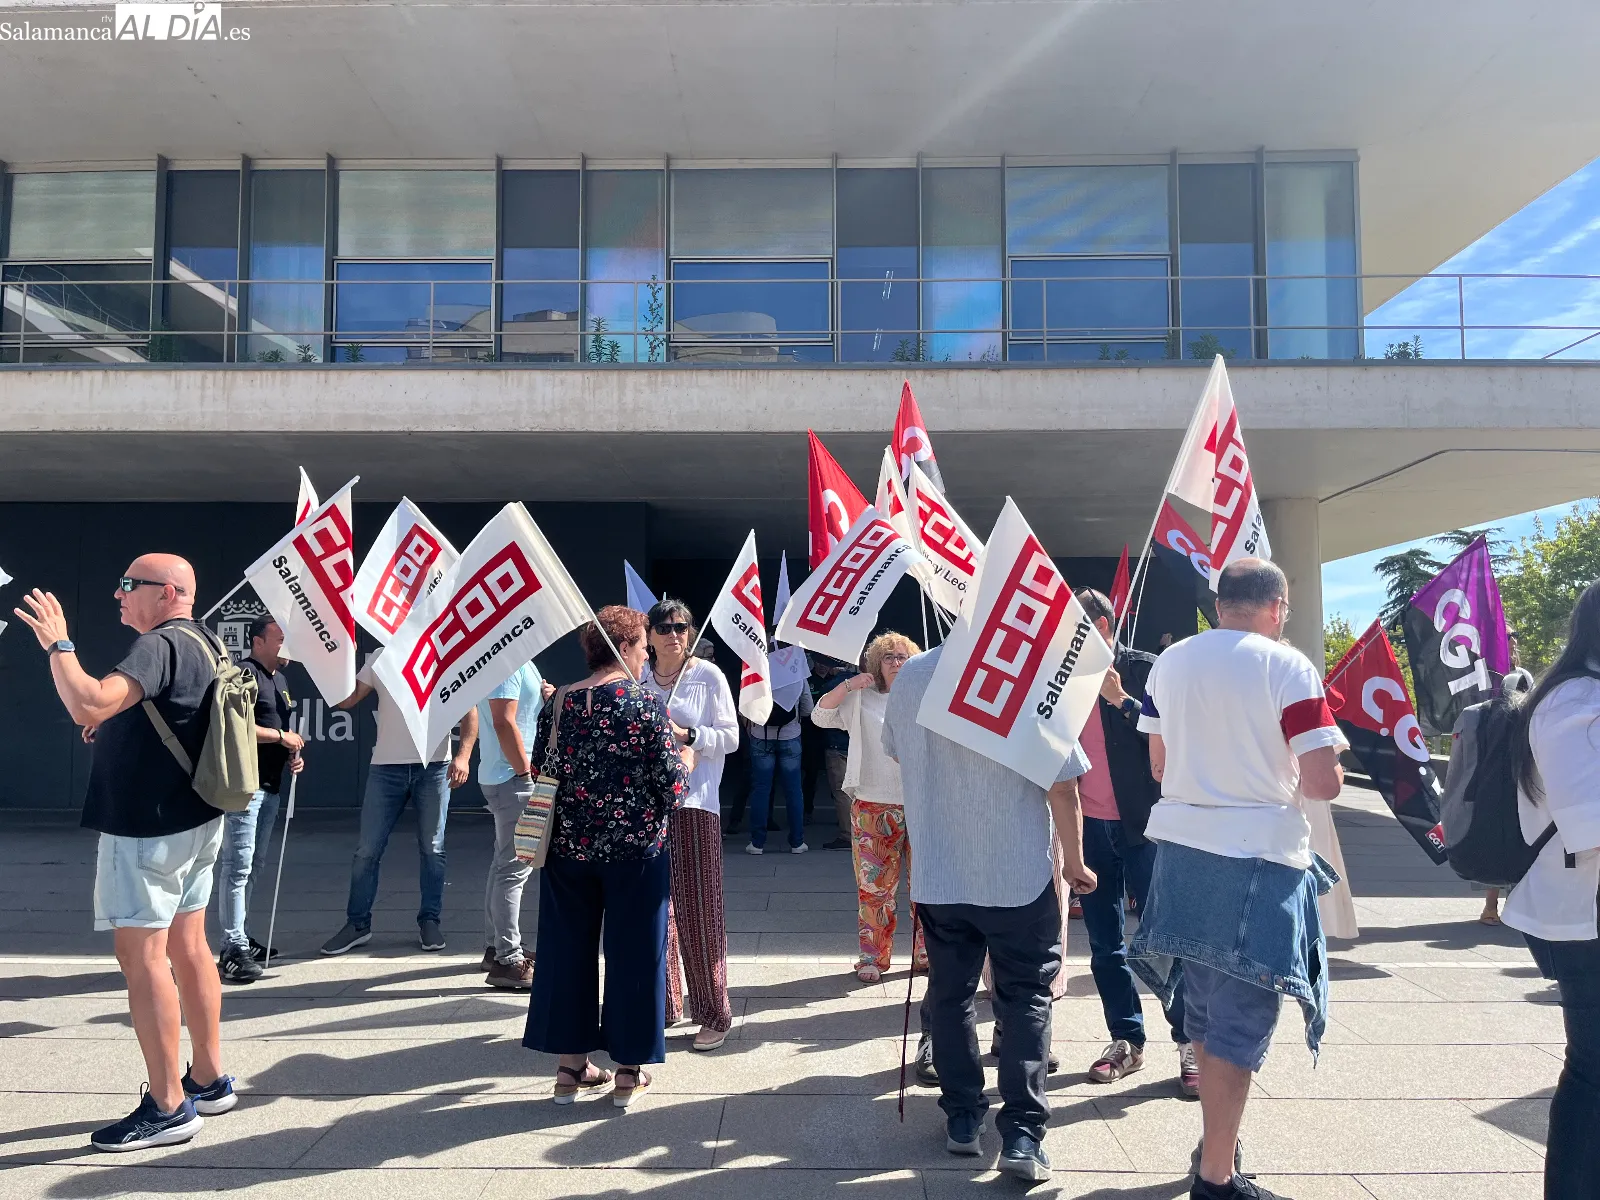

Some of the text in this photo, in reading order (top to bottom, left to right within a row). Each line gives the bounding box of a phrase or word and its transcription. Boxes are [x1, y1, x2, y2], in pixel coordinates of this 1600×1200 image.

[272, 555, 338, 654] Salamanca
[806, 524, 897, 624] CCOO
[848, 544, 912, 616] Salamanca
[943, 570, 967, 593] Leó
[412, 557, 526, 696] CCOO
[439, 614, 535, 705] Salamanca
[962, 550, 1064, 719] CCOO
[1433, 588, 1492, 696] CGT
[1428, 832, 1445, 853] CGT
